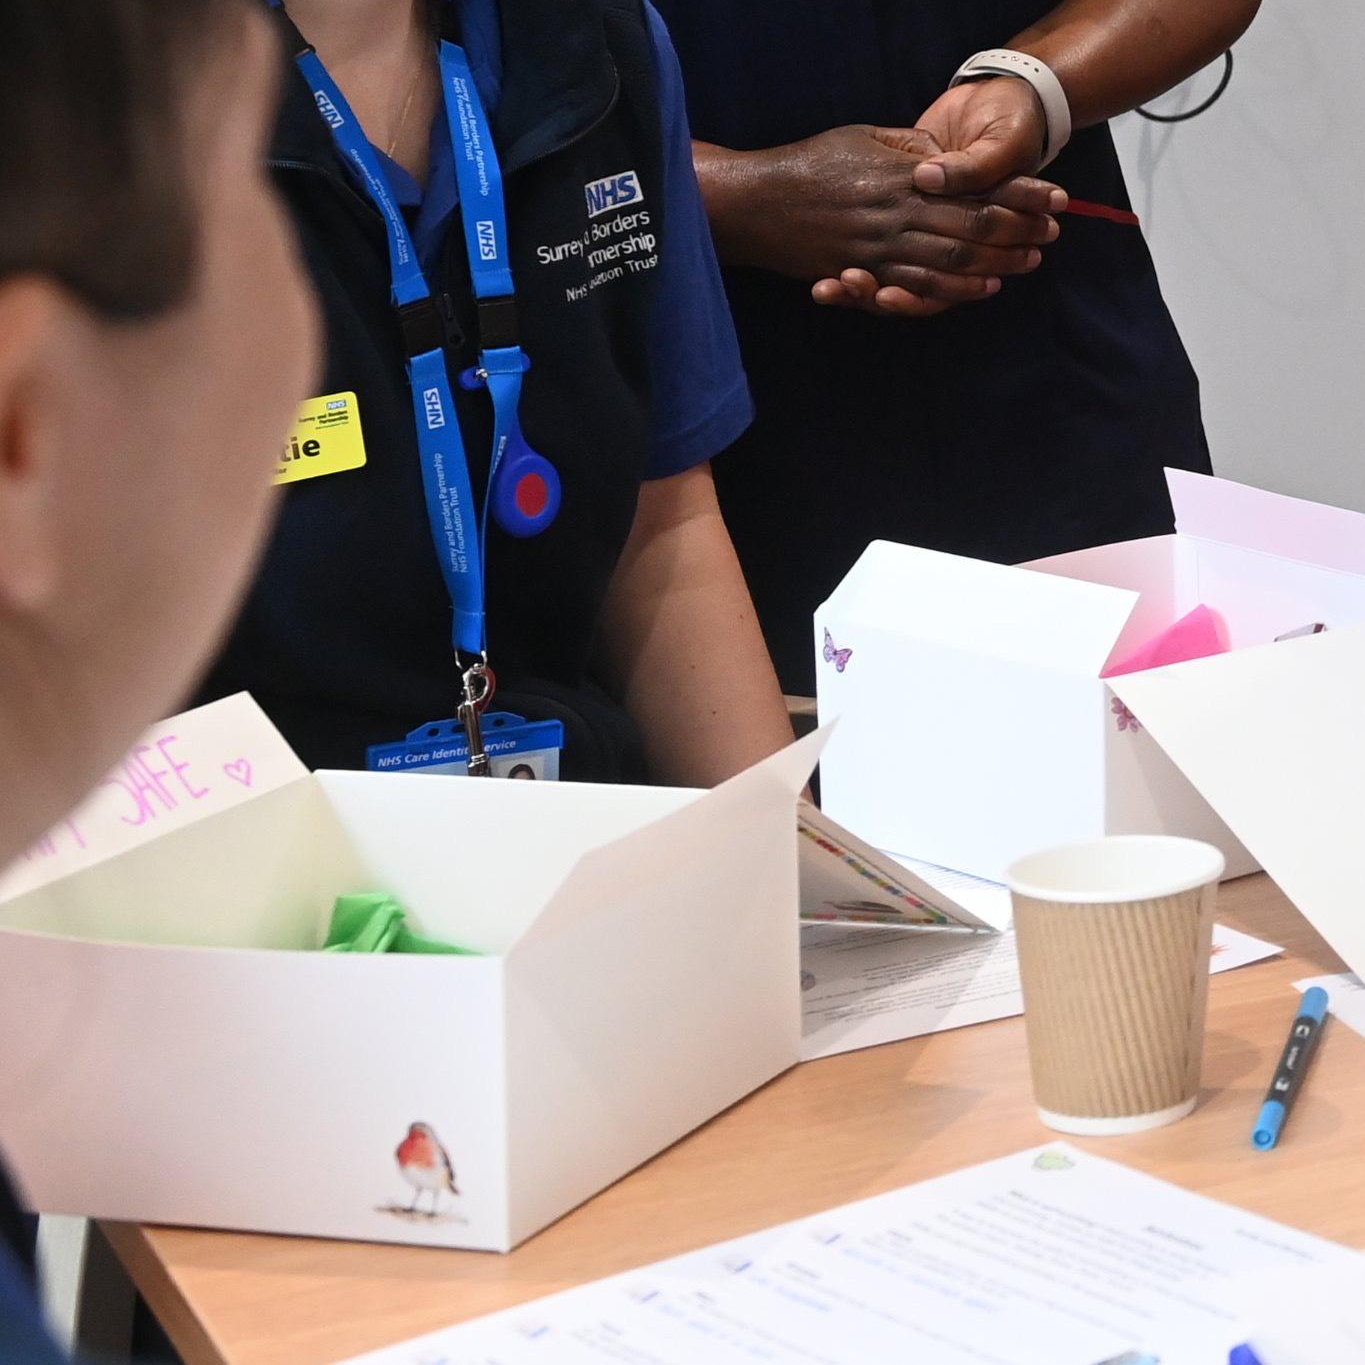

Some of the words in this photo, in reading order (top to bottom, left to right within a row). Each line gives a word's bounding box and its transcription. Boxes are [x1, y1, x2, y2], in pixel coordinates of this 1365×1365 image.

[316, 92, 342, 125] NHS
[456, 95, 470, 140] Foundation
[464, 142, 474, 161] Trust
[468, 119, 482, 149] Borders
[472, 149, 490, 196] Partnership
[586, 174, 637, 215] NHS
[479, 222, 496, 258] NHS
[536, 238, 585, 265] Surrey
[591, 211, 651, 241] Borders
[566, 283, 588, 302] NHS
[625, 254, 659, 274] Trust
[425, 389, 444, 427] NHS
[432, 452, 447, 499] Partnership
[440, 500, 454, 529] Borders
[448, 486, 458, 507] Trust
[444, 530, 455, 546] and
[452, 507, 466, 554] Foundation
[458, 555, 469, 573] NHS
[378, 755, 402, 768] NHS
[404, 752, 430, 764] Care
[432, 746, 470, 760] Identit
[483, 740, 517, 753] ervice
